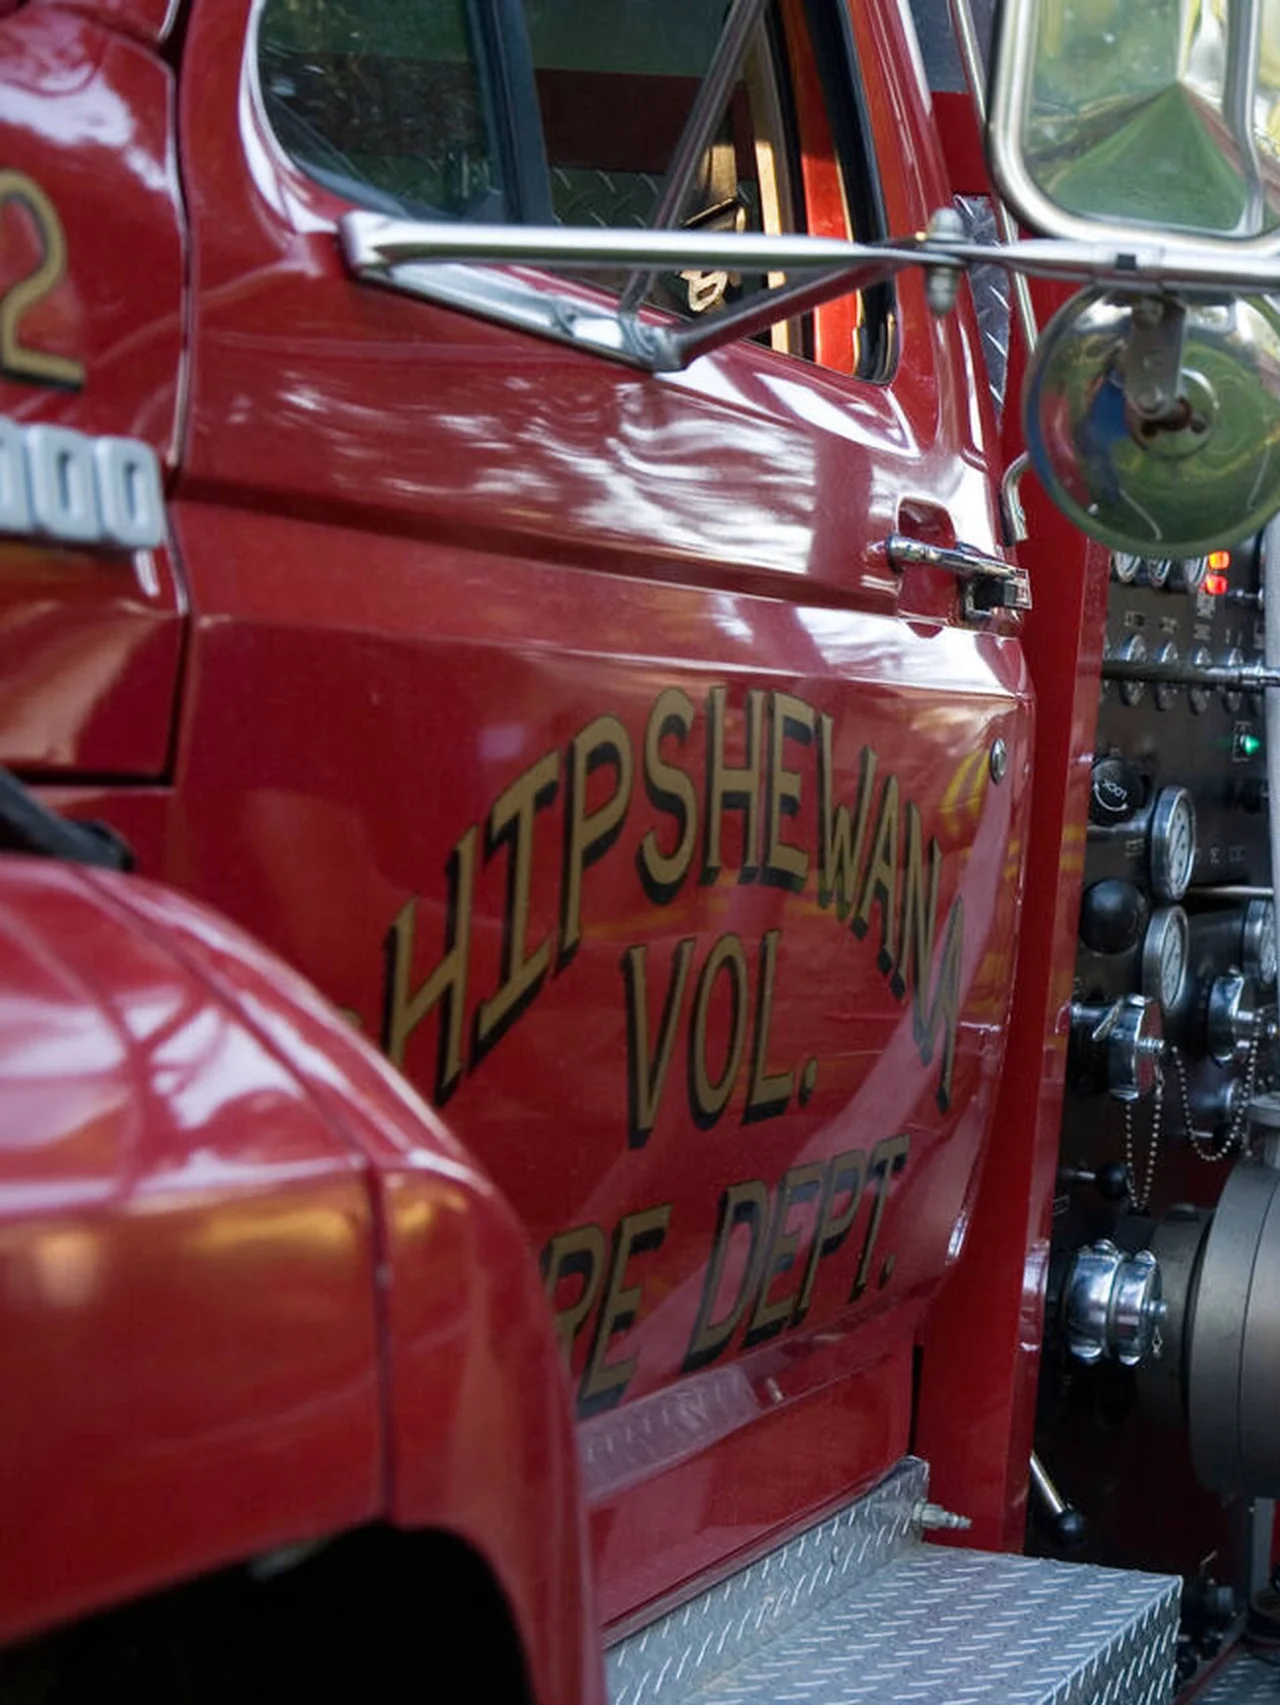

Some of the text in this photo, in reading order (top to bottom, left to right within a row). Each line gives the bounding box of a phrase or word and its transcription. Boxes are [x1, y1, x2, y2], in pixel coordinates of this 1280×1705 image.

[0, 168, 86, 393] 2
[337, 685, 967, 1112] HIPSHEWANA
[619, 929, 819, 1150] VOL.
[539, 1133, 910, 1421] RE DEPT.
